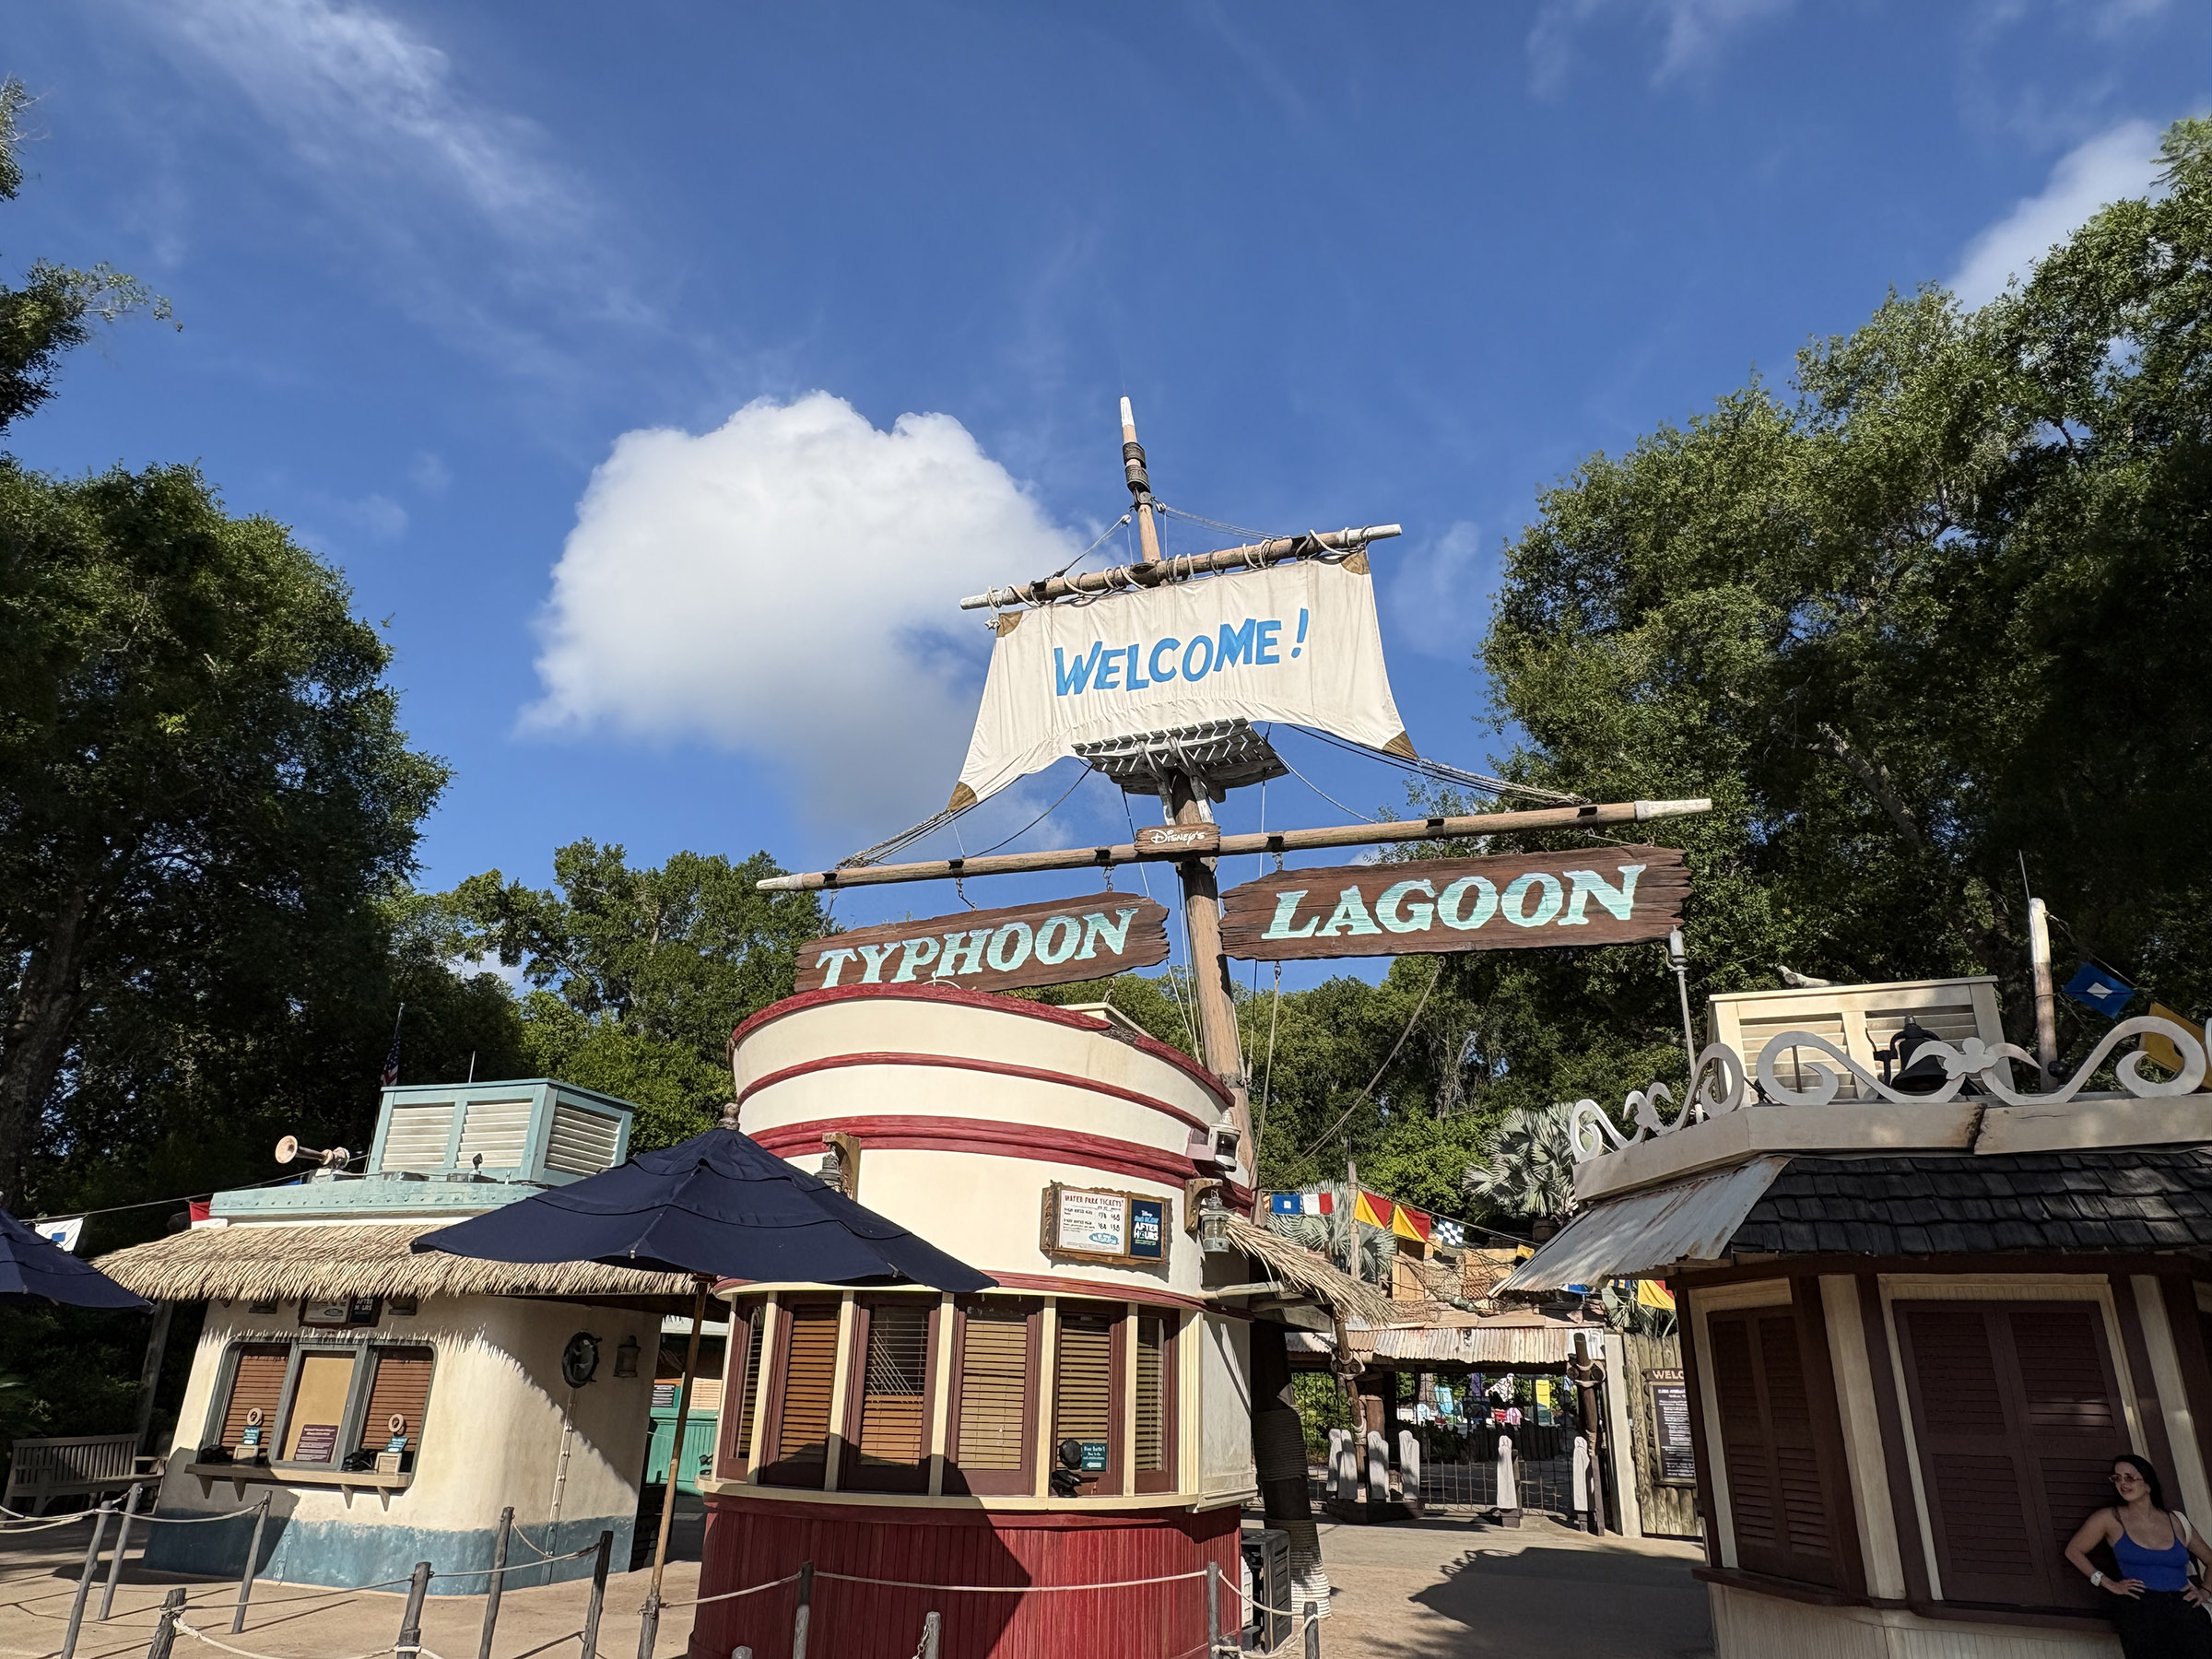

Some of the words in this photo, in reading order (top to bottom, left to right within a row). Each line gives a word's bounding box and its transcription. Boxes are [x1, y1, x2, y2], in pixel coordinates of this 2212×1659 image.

[1261, 864, 1647, 939] LAGOON
[816, 907, 1139, 990] TYPHOON
[1135, 1222, 1159, 1232] AFTER
